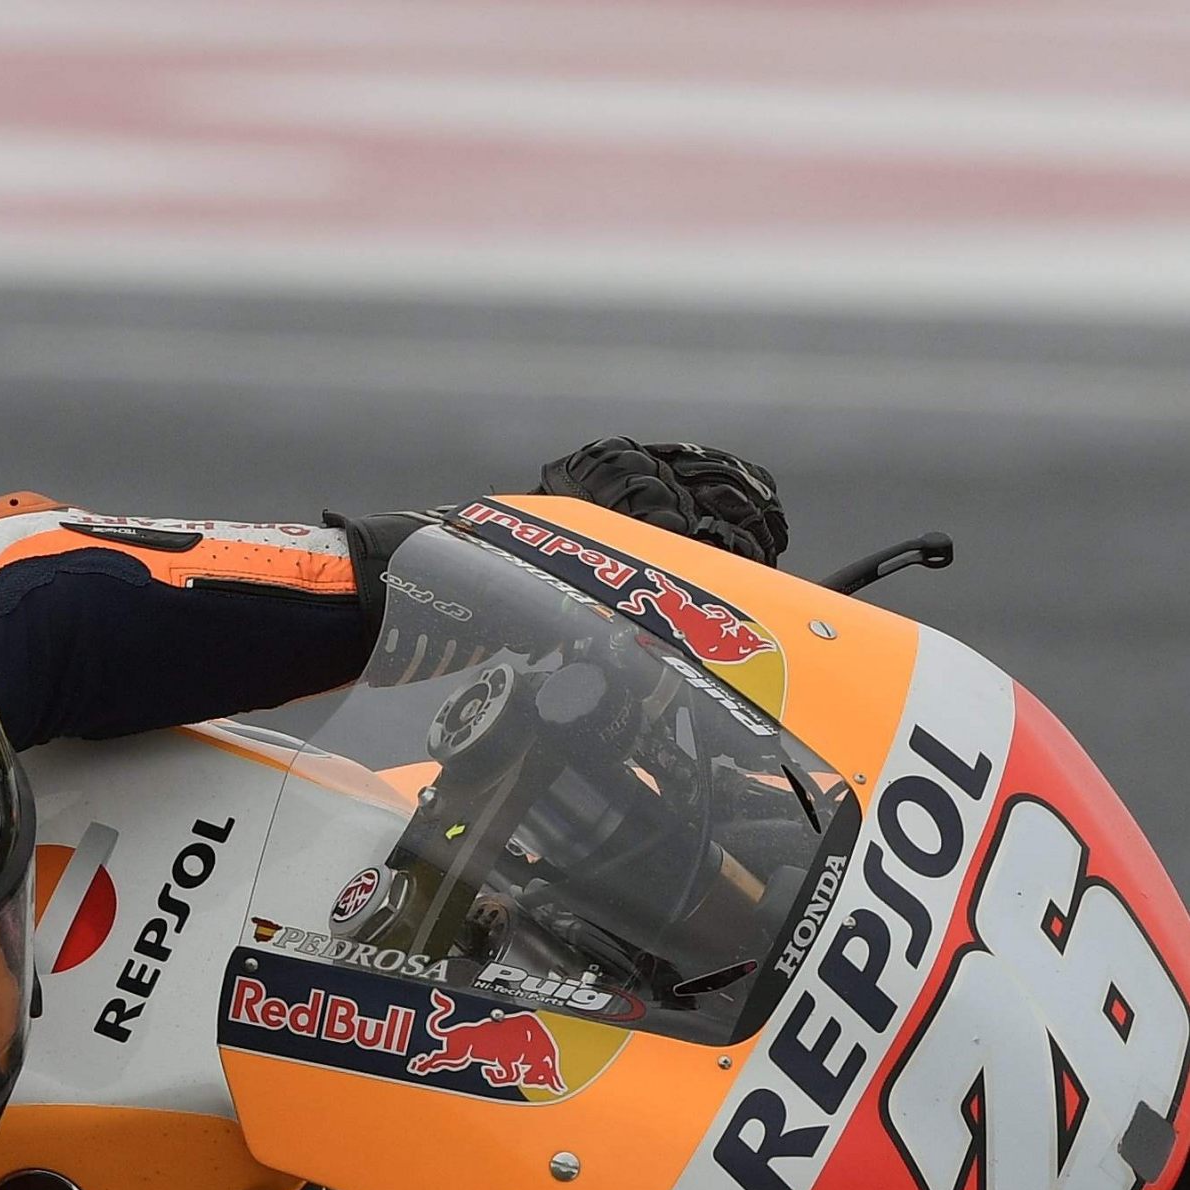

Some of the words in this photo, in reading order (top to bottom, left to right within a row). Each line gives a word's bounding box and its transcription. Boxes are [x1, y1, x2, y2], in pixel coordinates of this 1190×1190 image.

[458, 502, 555, 547] Bull
[540, 534, 638, 590] Red
[93, 815, 236, 1044] REPSOL
[773, 853, 848, 979] HONDA
[273, 927, 450, 982] PEDROSA
[477, 961, 614, 1011] Puig
[528, 991, 565, 1007] Parts
[227, 975, 323, 1036] Red
[320, 987, 415, 1057] Bull
